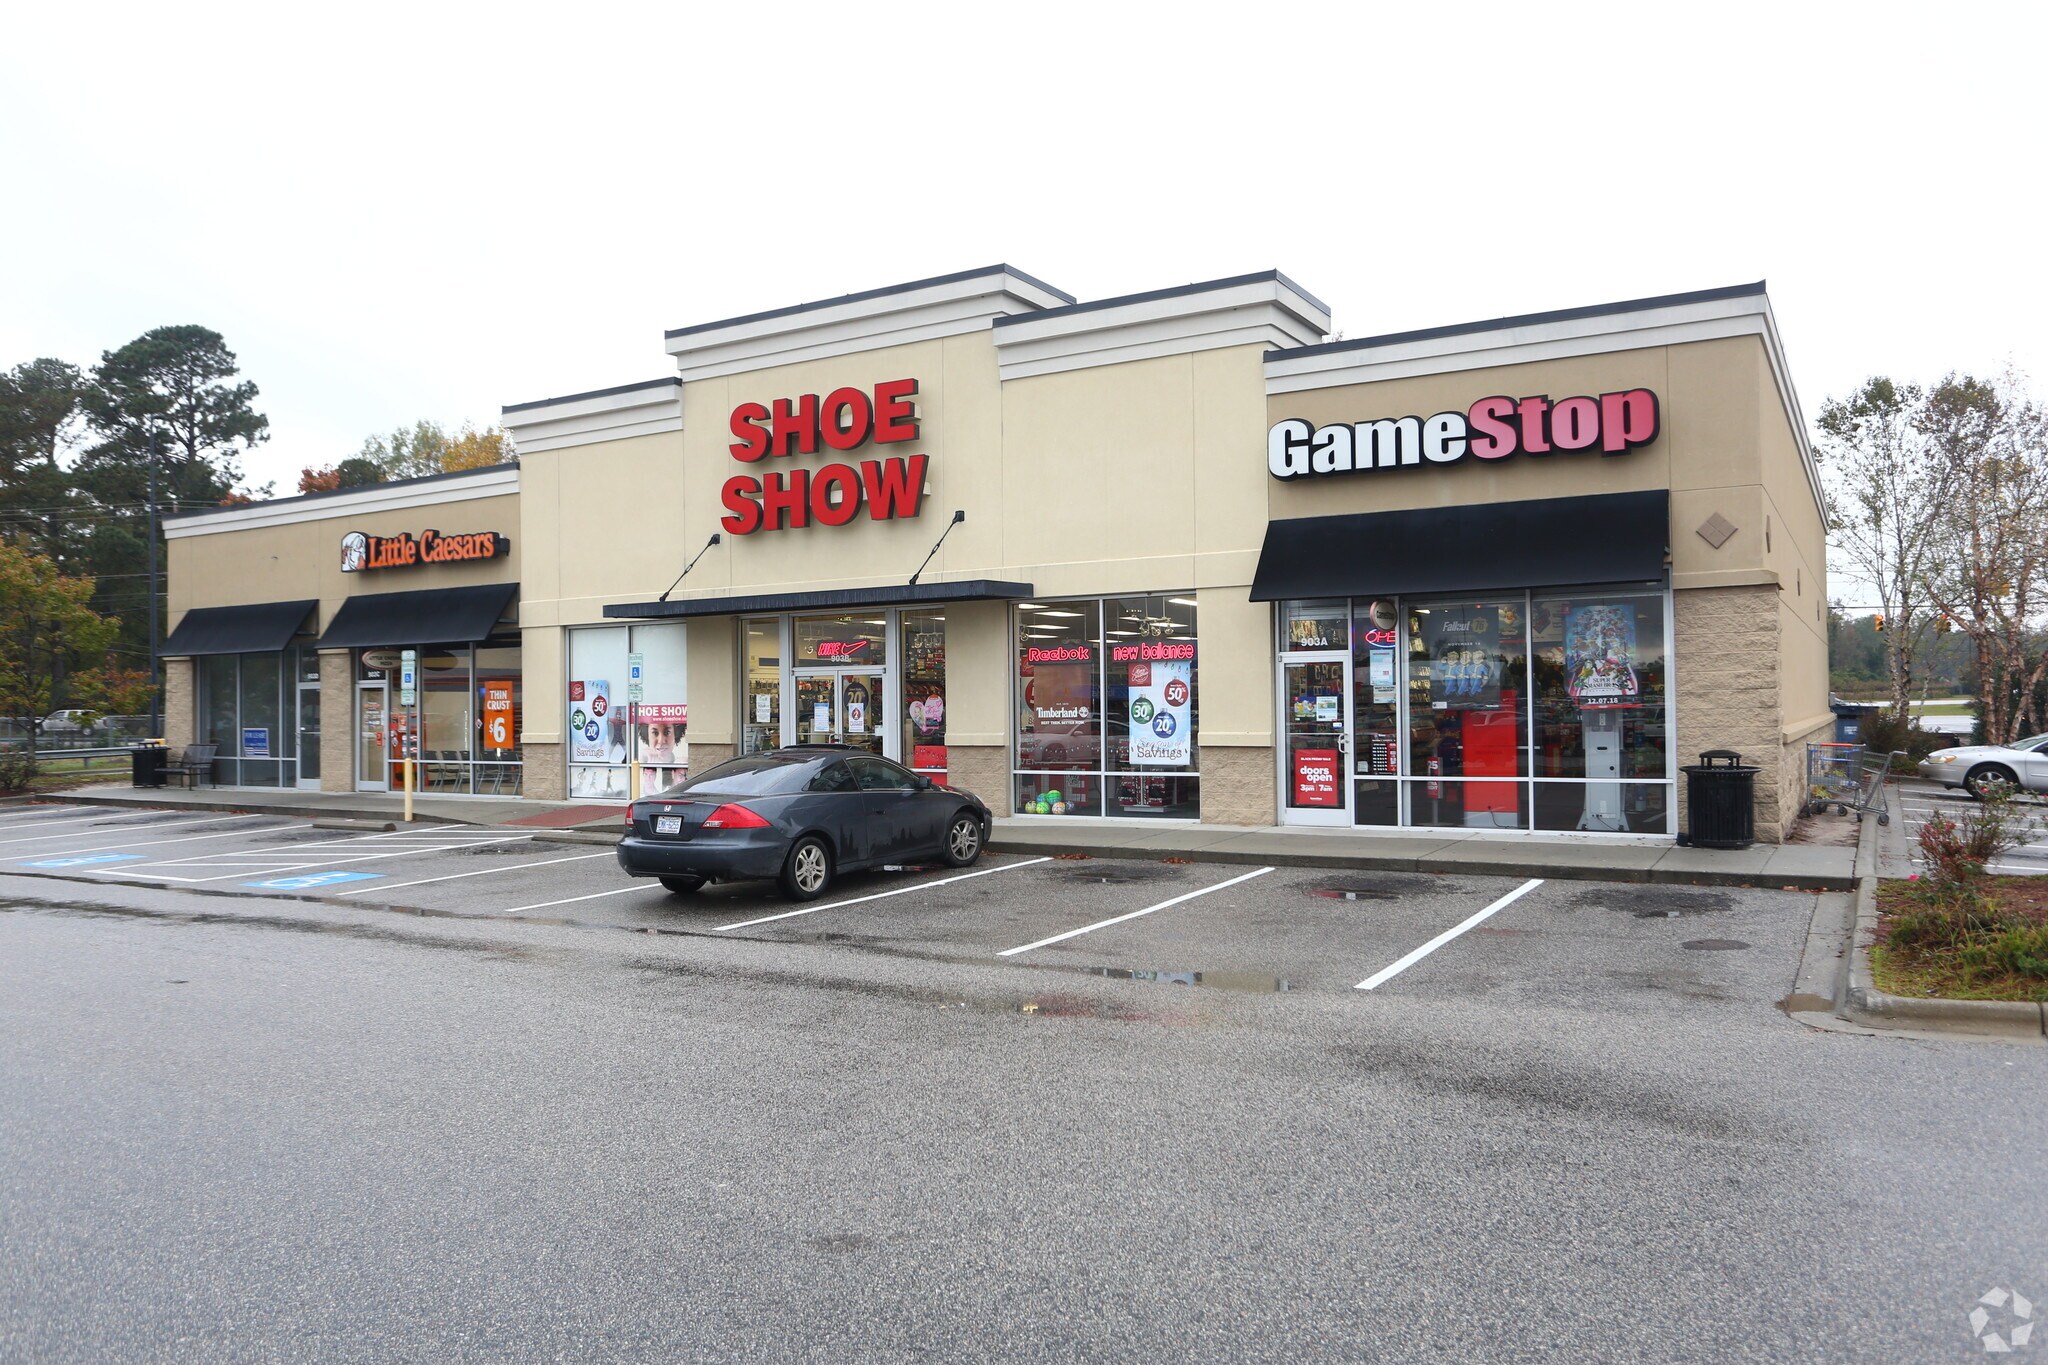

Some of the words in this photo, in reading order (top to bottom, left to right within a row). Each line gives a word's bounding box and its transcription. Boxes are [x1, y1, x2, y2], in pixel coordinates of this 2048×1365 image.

[729, 378, 920, 463] SHOE
[1268, 387, 1660, 482] GameStop
[721, 454, 929, 535] SHOW
[368, 533, 416, 568] Little
[420, 529, 495, 563] Caesars
[1442, 620, 1471, 632] Fallout
[1301, 636, 1328, 647] 903A
[1365, 630, 1397, 643] OPE
[817, 641, 842, 656] NIKE
[1028, 646, 1090, 661] Reebok
[1113, 646, 1139, 661] new
[1141, 642, 1194, 659] balance
[831, 654, 850, 663] 903B
[489, 690, 508, 700] THIN
[487, 700, 511, 710] CRUST
[1036, 706, 1078, 718] Timberland
[489, 716, 506, 743] $6
[576, 748, 604, 758] Savings
[1137, 747, 1182, 760] Savings
[1300, 765, 1330, 775] doors
[1306, 774, 1333, 783] open
